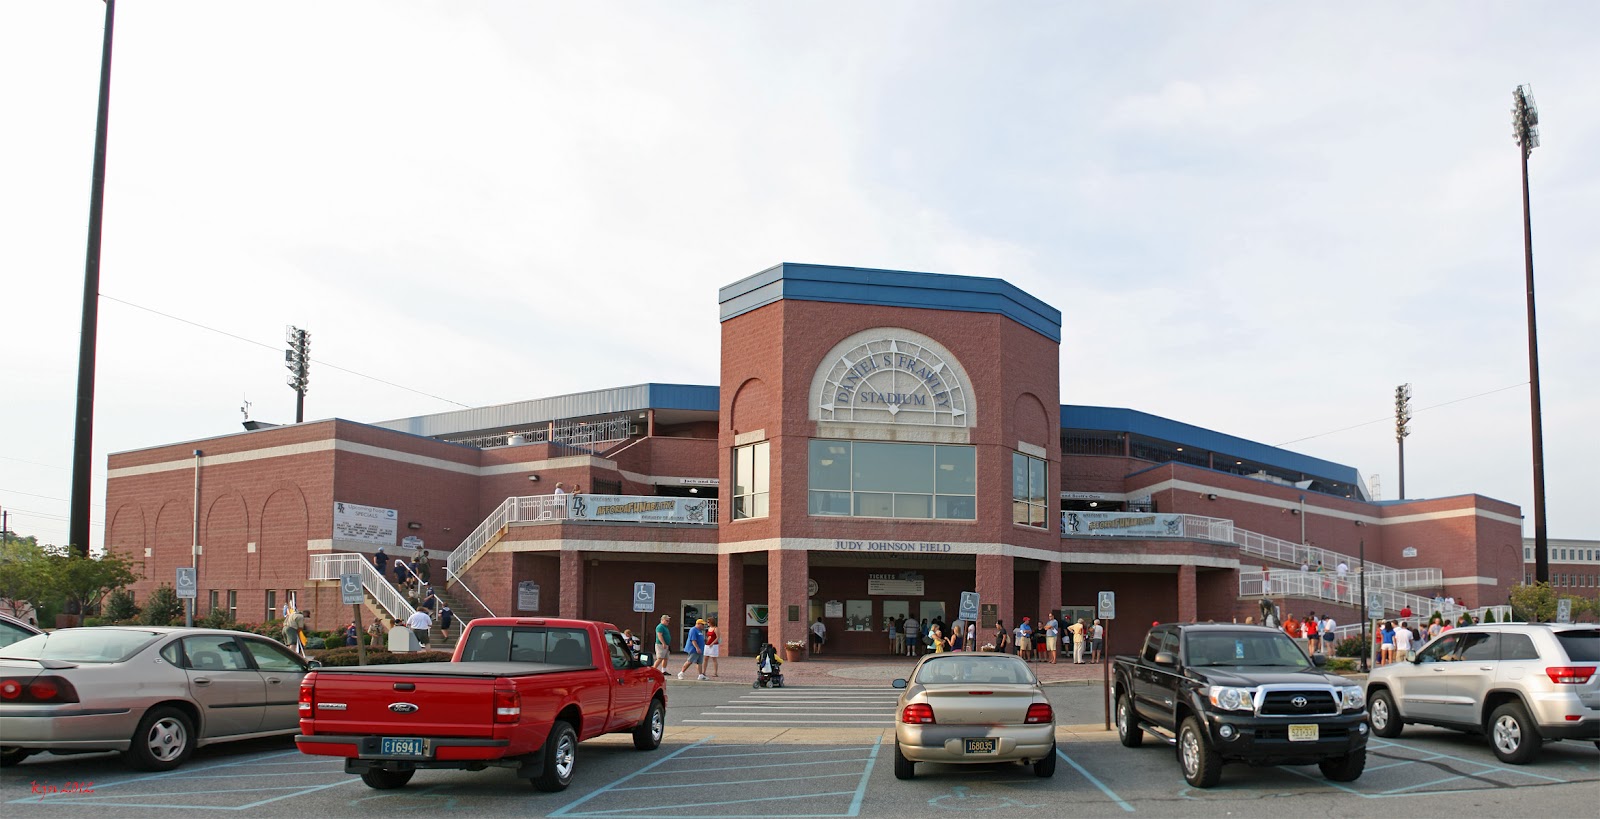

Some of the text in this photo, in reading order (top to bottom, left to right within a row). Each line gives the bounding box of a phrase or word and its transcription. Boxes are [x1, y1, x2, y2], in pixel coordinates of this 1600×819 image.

[837, 358, 880, 404] DANIEL
[899, 356, 950, 408] FRAWLEY
[860, 391, 926, 405] STADIUM
[835, 541, 951, 552] JUDY JOHNSON FIELD
[391, 742, 419, 753] 16941
[969, 741, 992, 750] 168035
